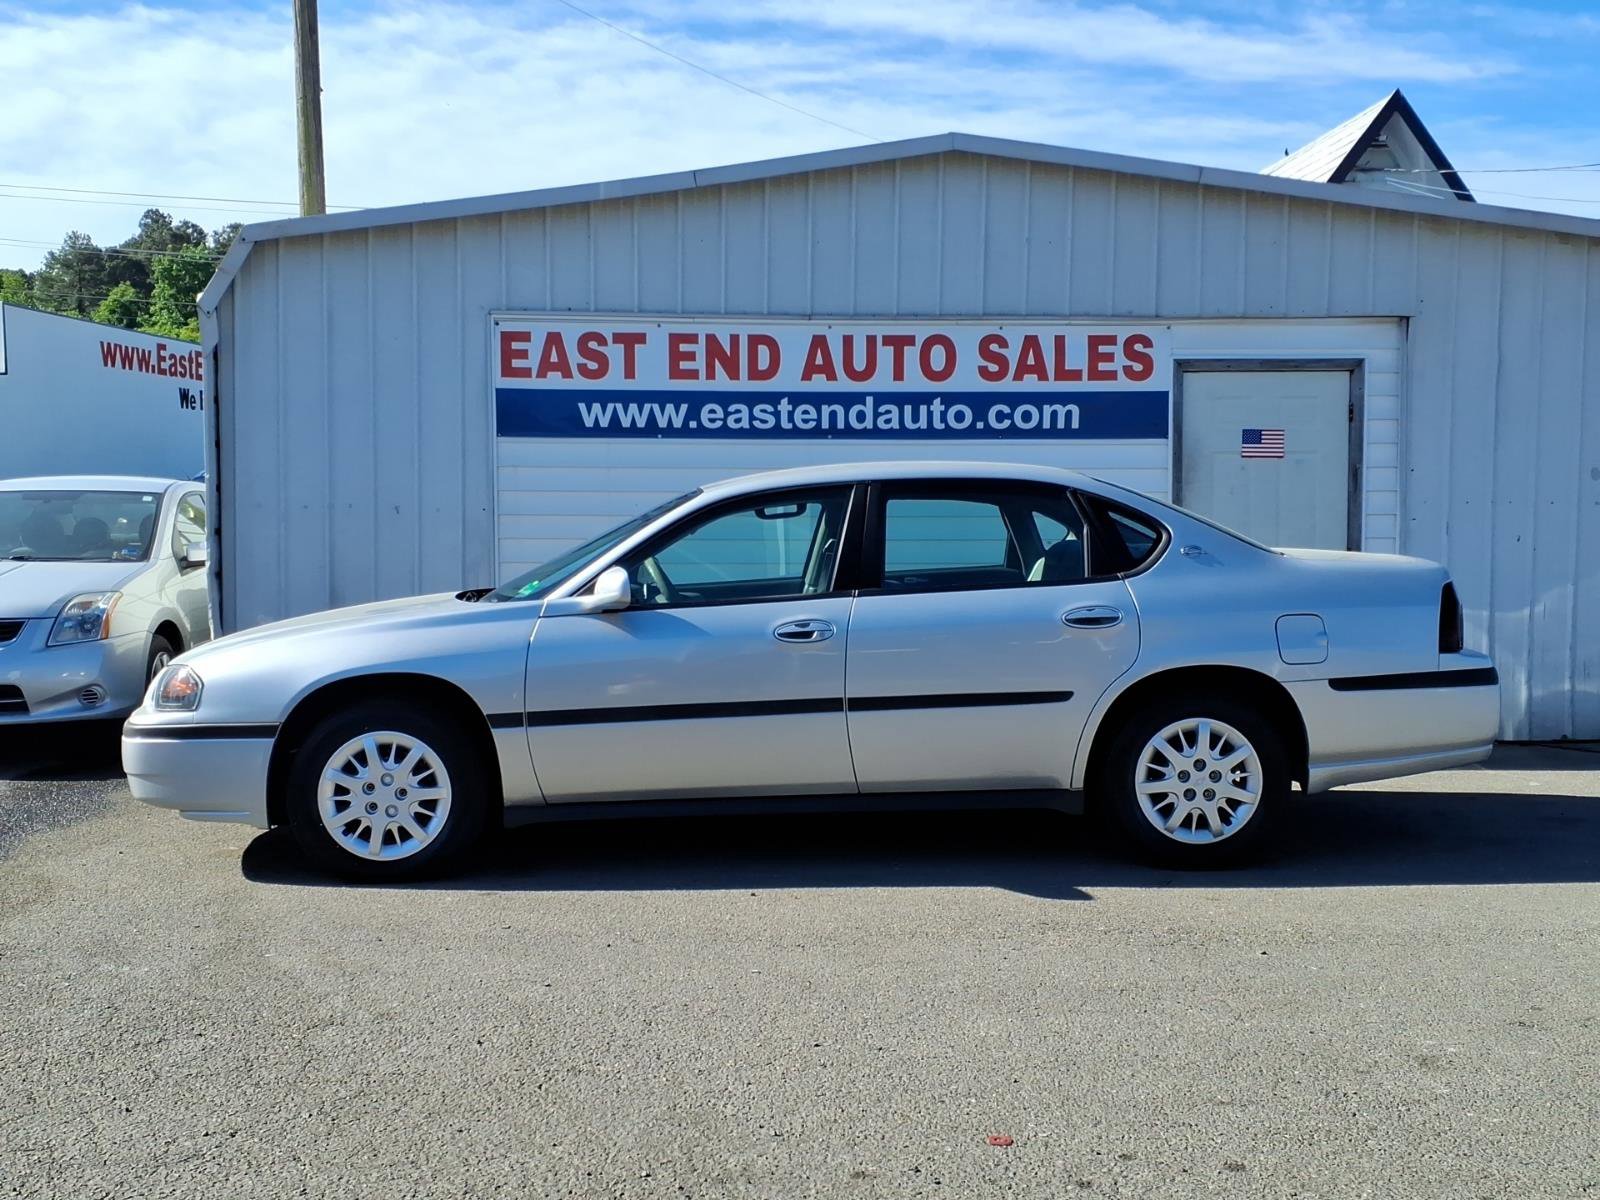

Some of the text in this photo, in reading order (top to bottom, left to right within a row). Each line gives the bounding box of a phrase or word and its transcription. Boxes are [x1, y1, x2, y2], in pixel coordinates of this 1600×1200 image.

[500, 331, 1154, 382] EAST END AUTO SALES
[178, 387, 196, 410] We
[578, 396, 1080, 429] www.eastendauto.com
